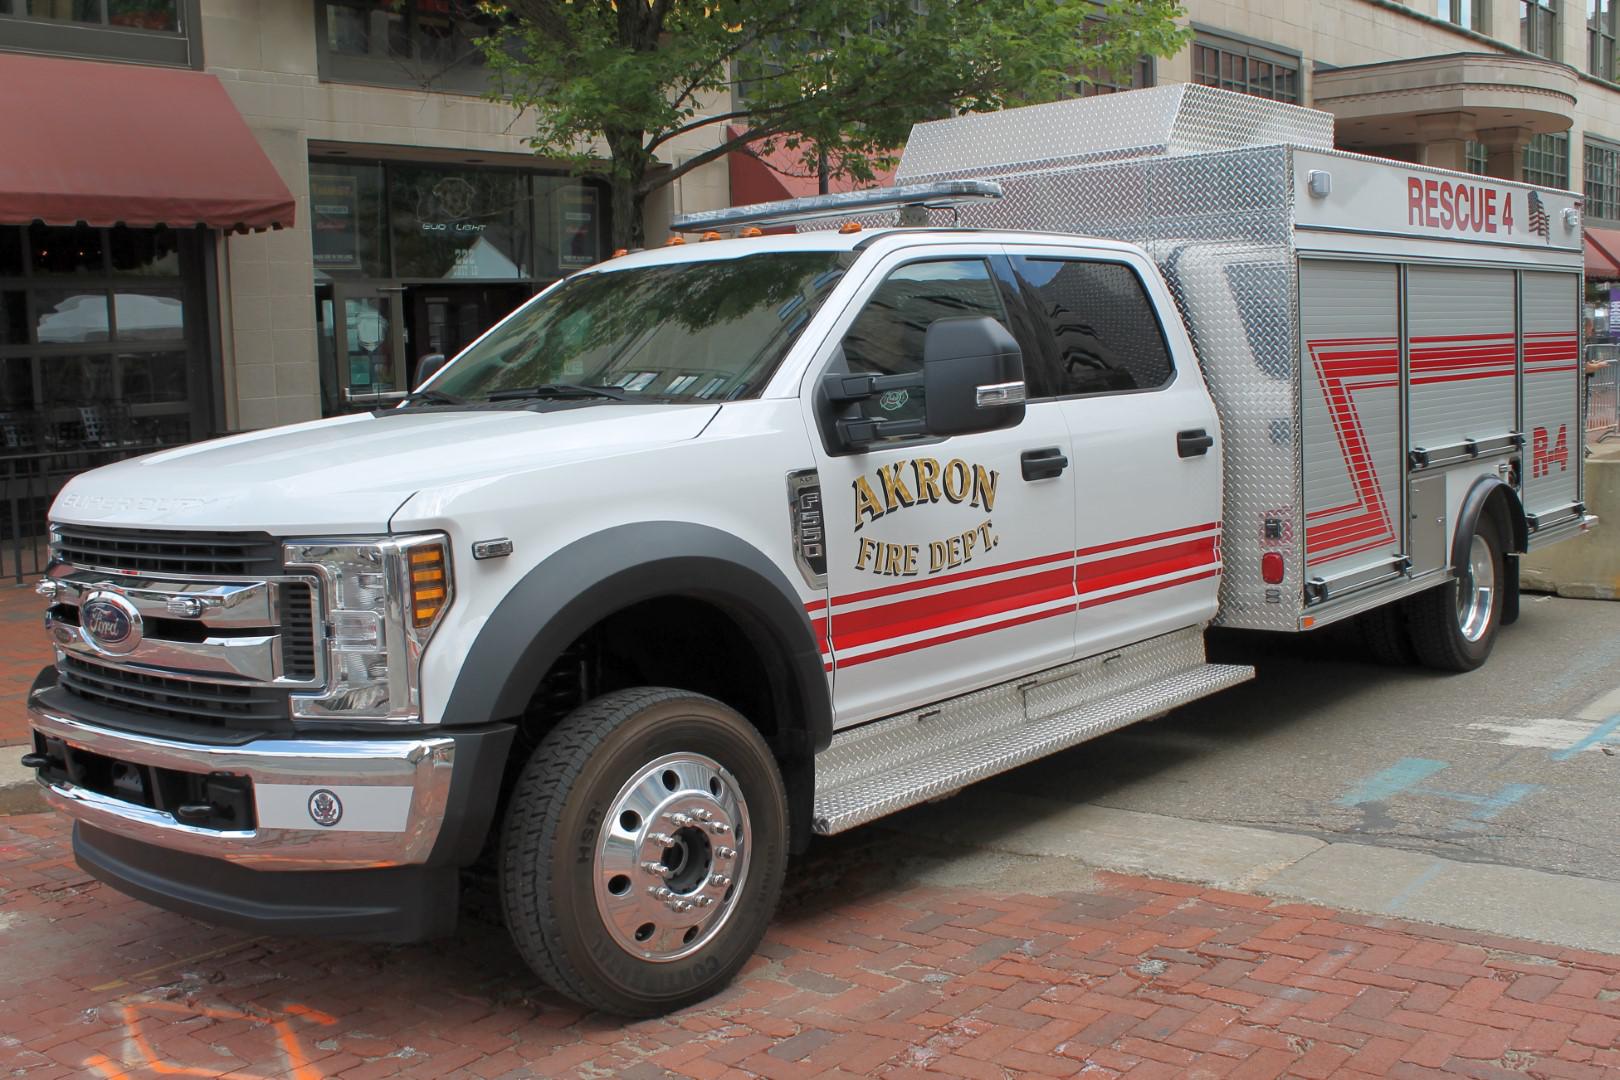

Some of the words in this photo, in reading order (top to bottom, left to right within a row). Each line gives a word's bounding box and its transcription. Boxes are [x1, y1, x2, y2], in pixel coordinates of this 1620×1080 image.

[422, 222, 447, 231] BUD
[455, 223, 487, 231] LIGHT
[1407, 176, 1497, 233] RESCUE
[1502, 192, 1513, 235] 4
[1533, 423, 1569, 480] R-4
[852, 457, 1000, 532] AKRON
[854, 536, 920, 577] FIRE
[928, 519, 1000, 575] DEPT.
[90, 606, 120, 637] Ford
